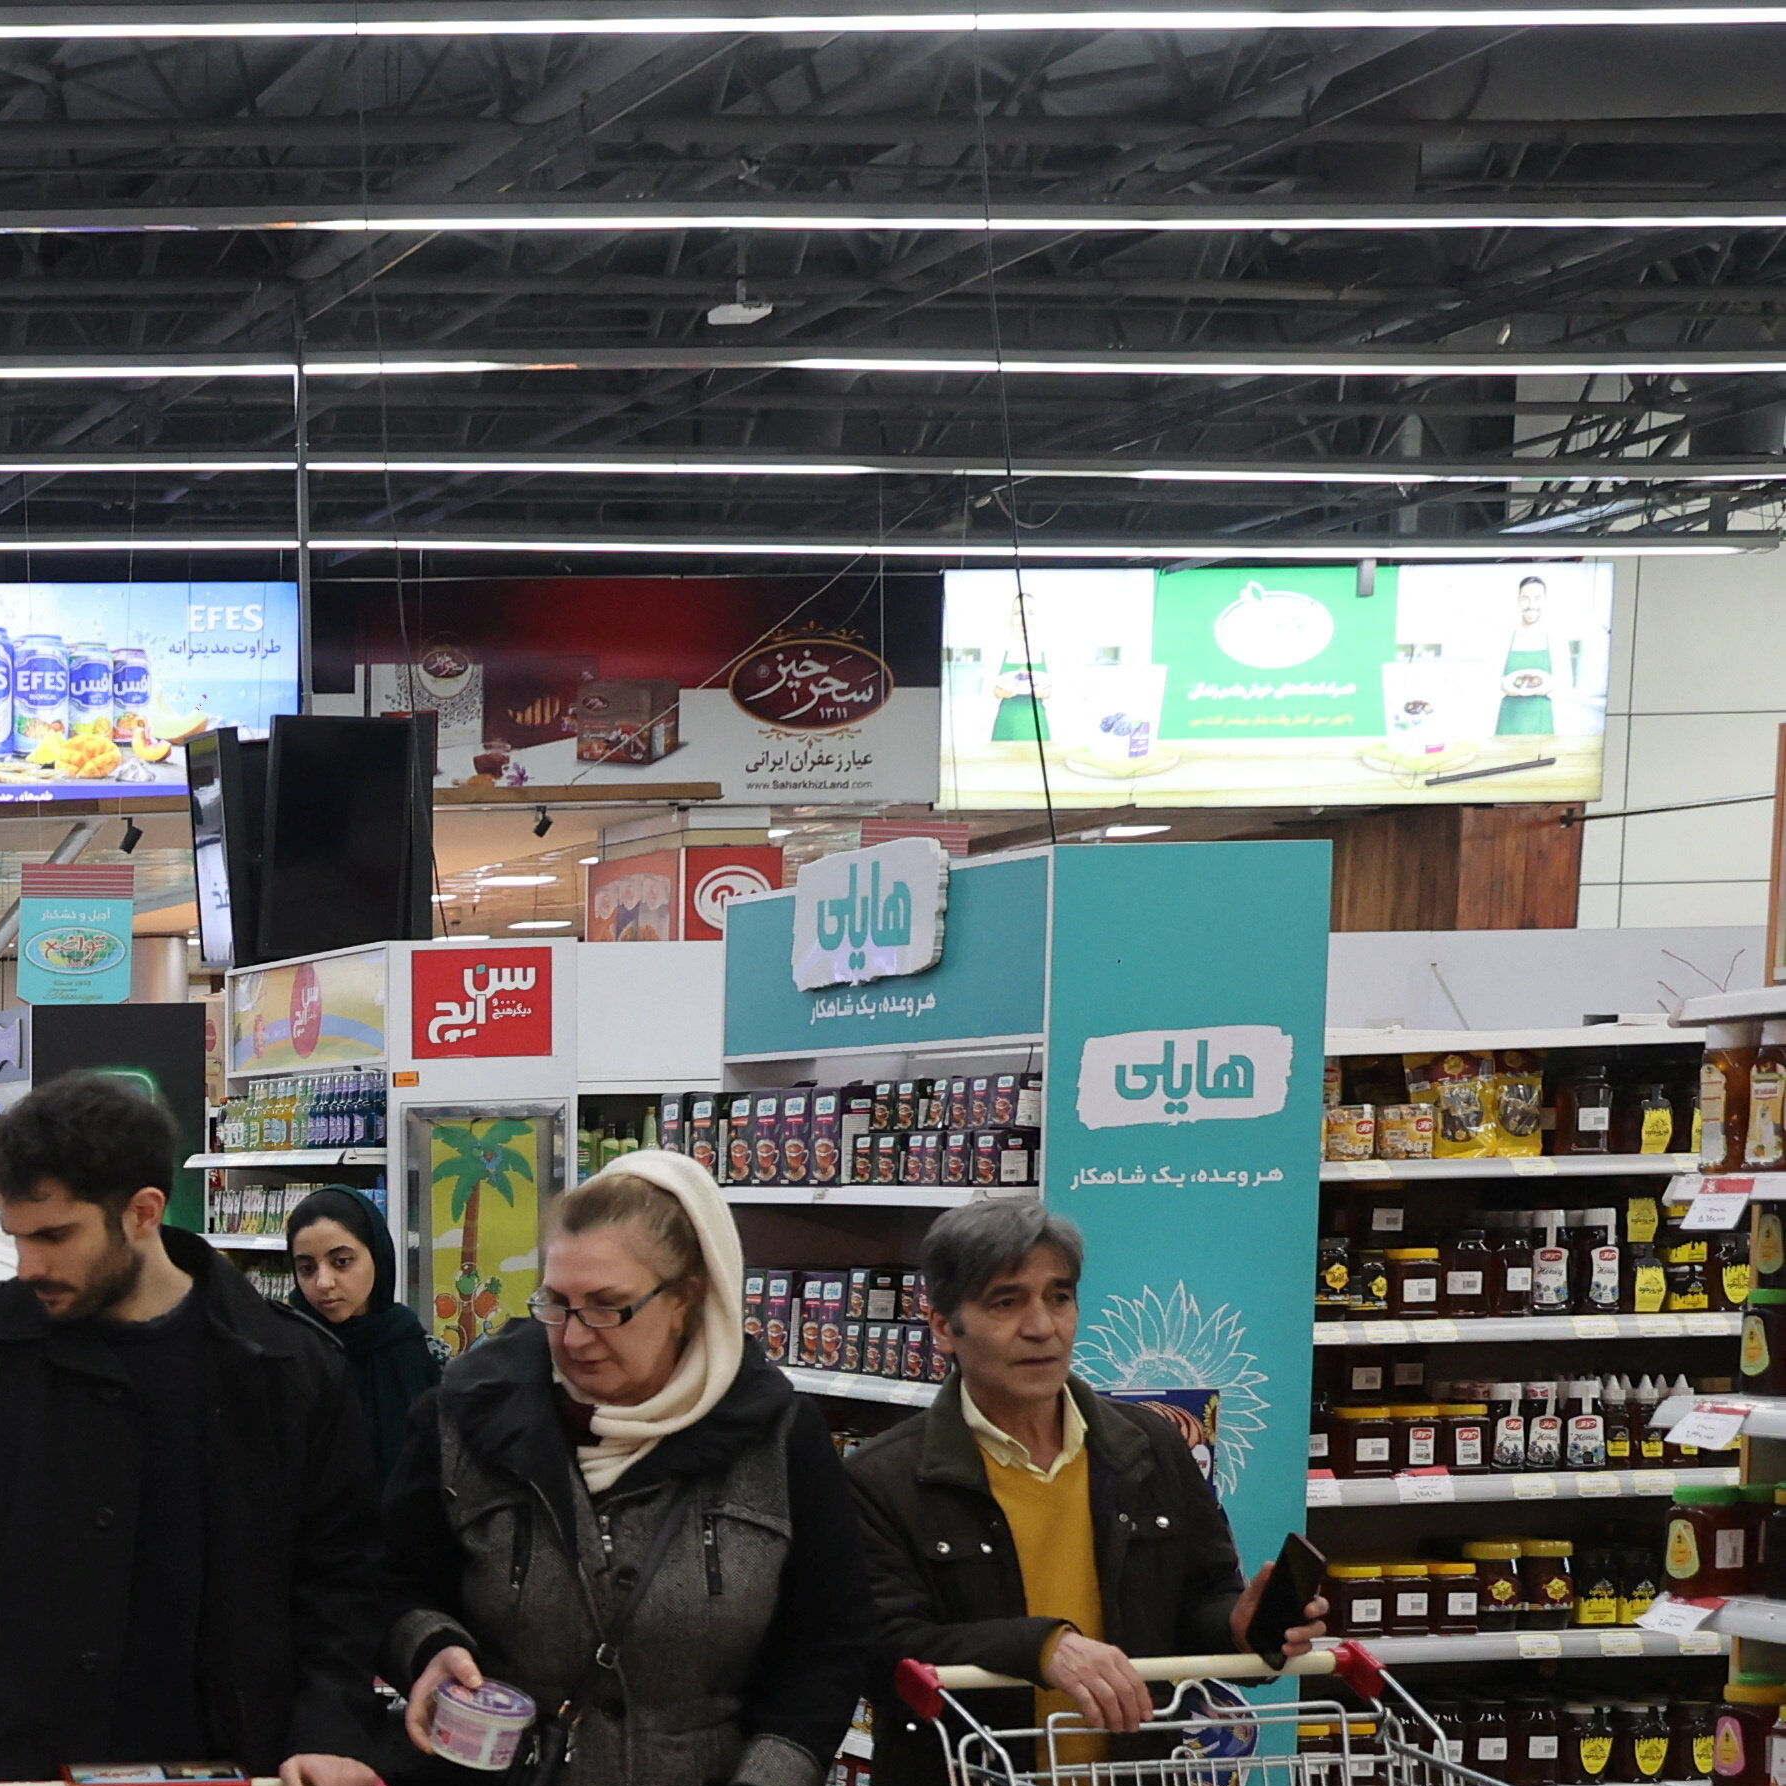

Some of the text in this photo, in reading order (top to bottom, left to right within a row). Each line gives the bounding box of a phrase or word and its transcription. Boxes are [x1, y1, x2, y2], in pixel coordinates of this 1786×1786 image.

[187, 603, 264, 633] EFES
[168, 639, 283, 660] طراوت مدیترانه
[16, 671, 67, 693] EFES
[745, 748, 873, 773] عیار زعفران ایرانی
[745, 778, 874, 791] www.SaharkhizLand.com
[88, 907, 112, 923] آجیل
[817, 861, 913, 971] هایلی
[463, 964, 538, 1000] سن
[428, 992, 488, 1044] ایچ
[810, 993, 854, 1026] شاهکار
[856, 993, 877, 1021] یک
[915, 992, 937, 1016] هر
[1114, 1038, 1255, 1116] هایلی
[1069, 1163, 1284, 1193] هر وعده، یک شاهکار
